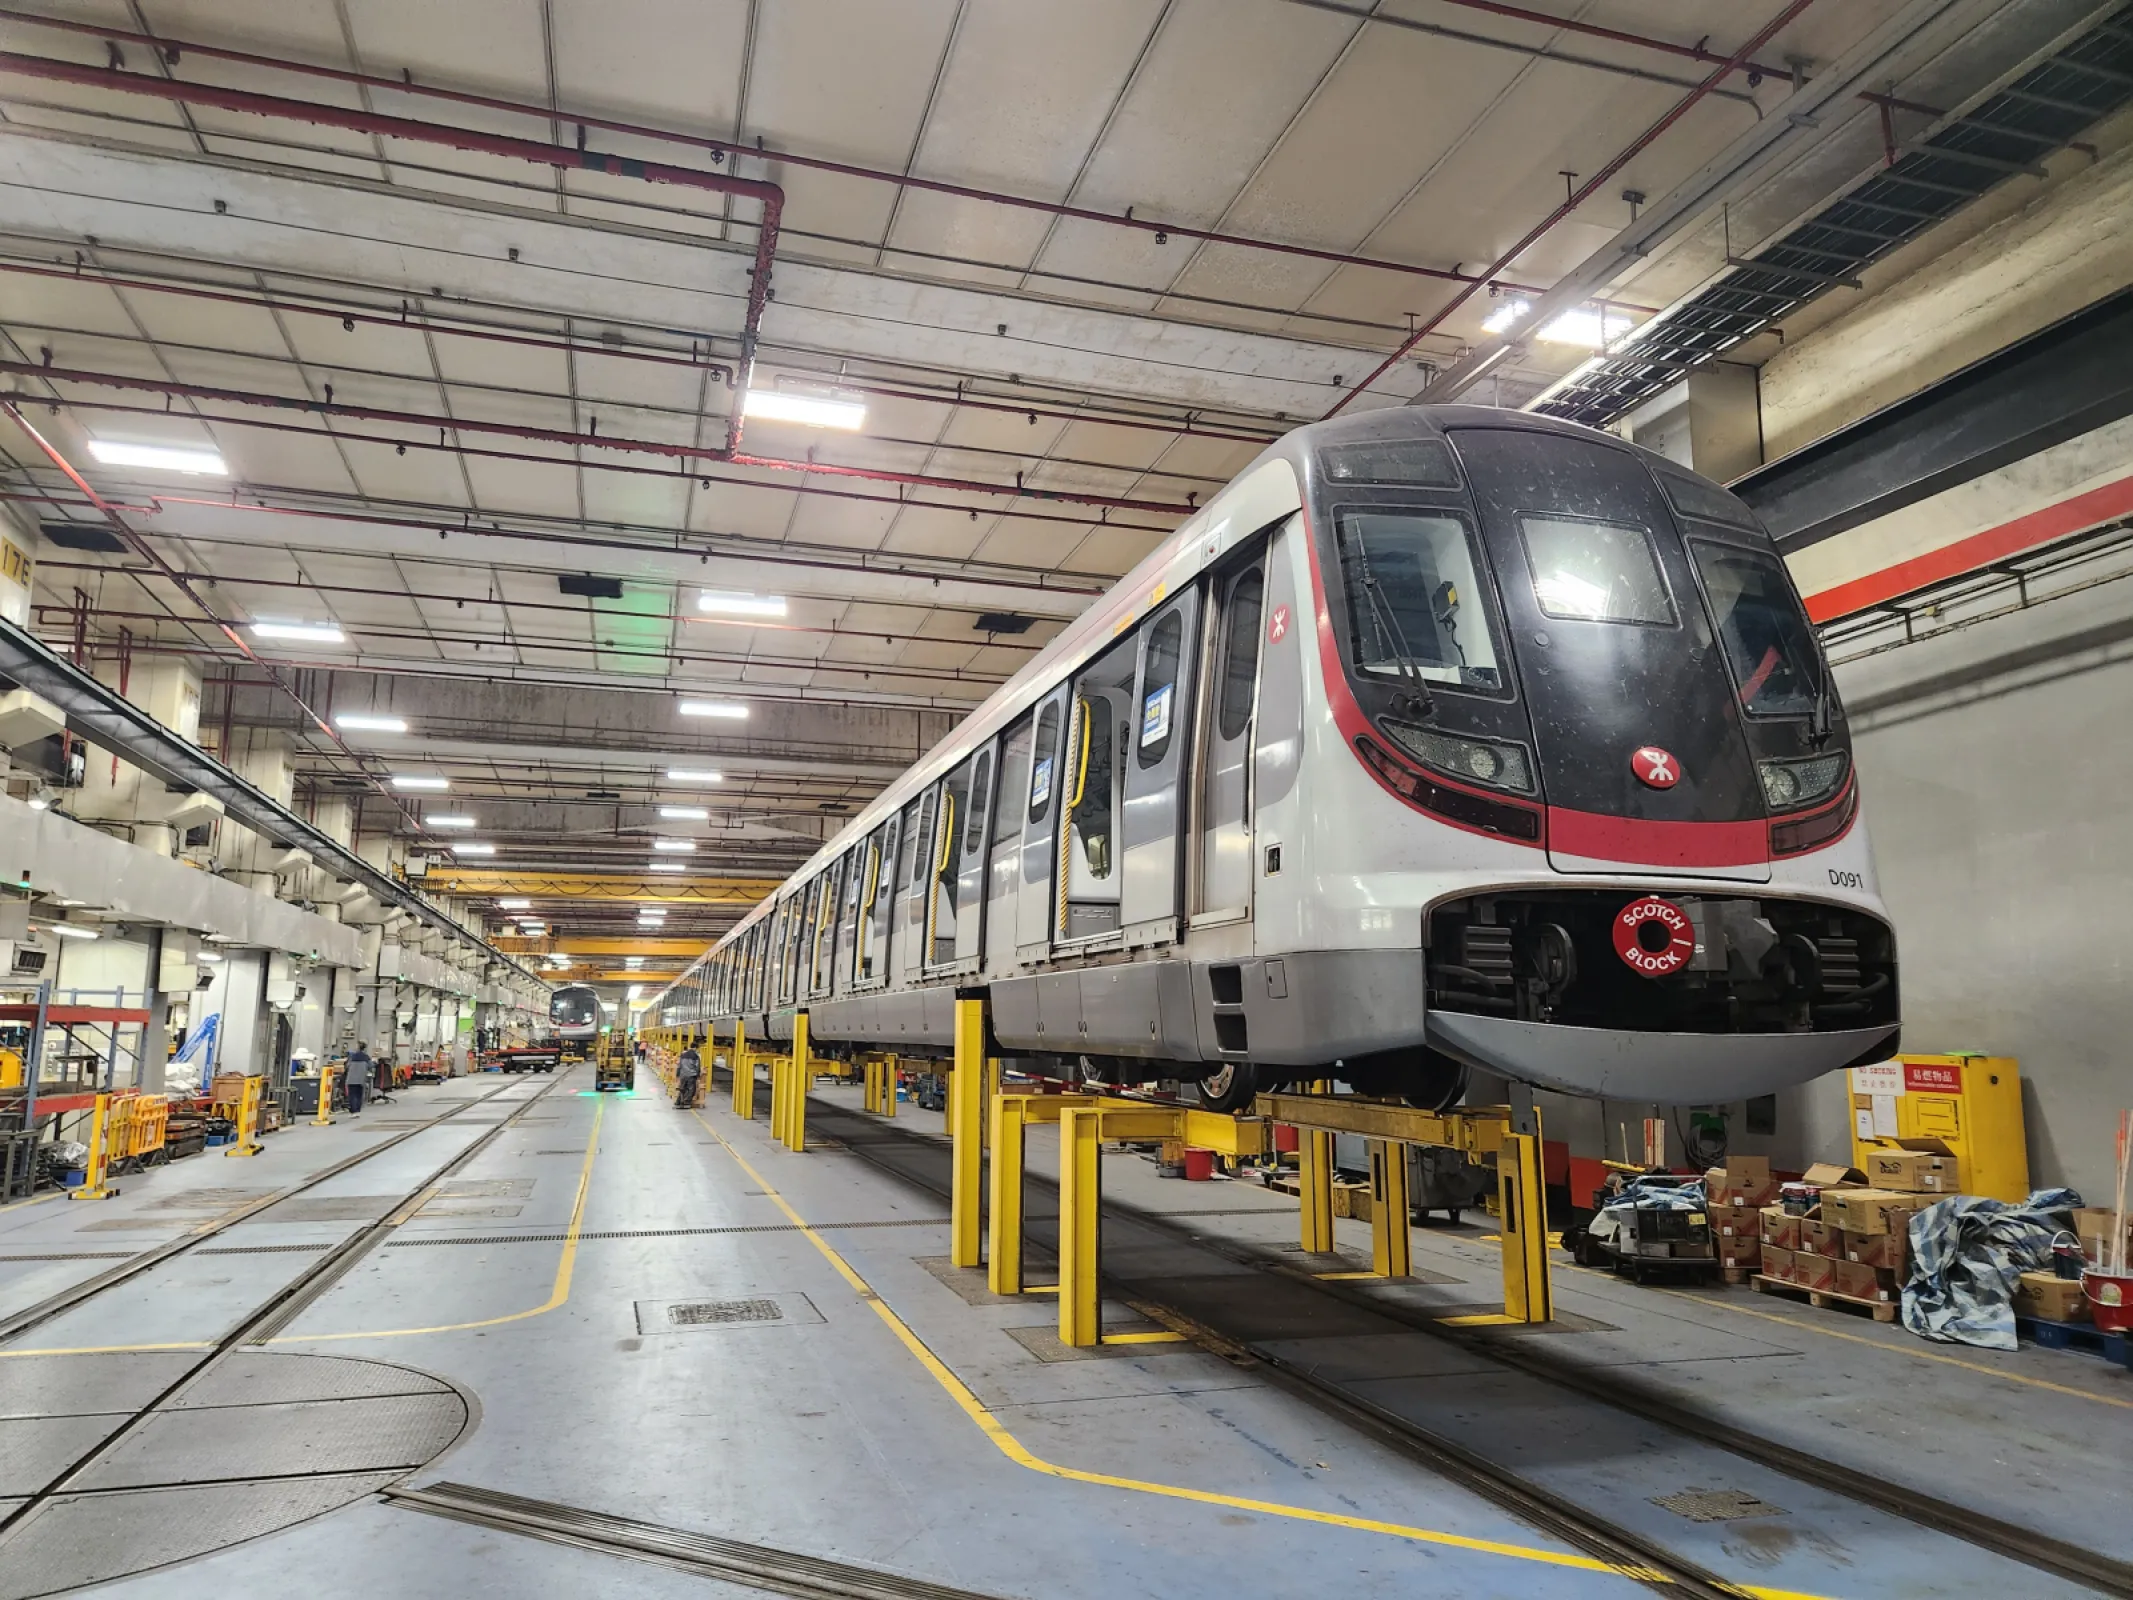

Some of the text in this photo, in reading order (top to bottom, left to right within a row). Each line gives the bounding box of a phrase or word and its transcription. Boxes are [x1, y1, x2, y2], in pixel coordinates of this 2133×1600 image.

[2, 544, 30, 587] 17E
[1828, 868, 1863, 889] D091
[1623, 903, 1685, 930] SCOTCH
[1625, 947, 1681, 970] BLOCK
